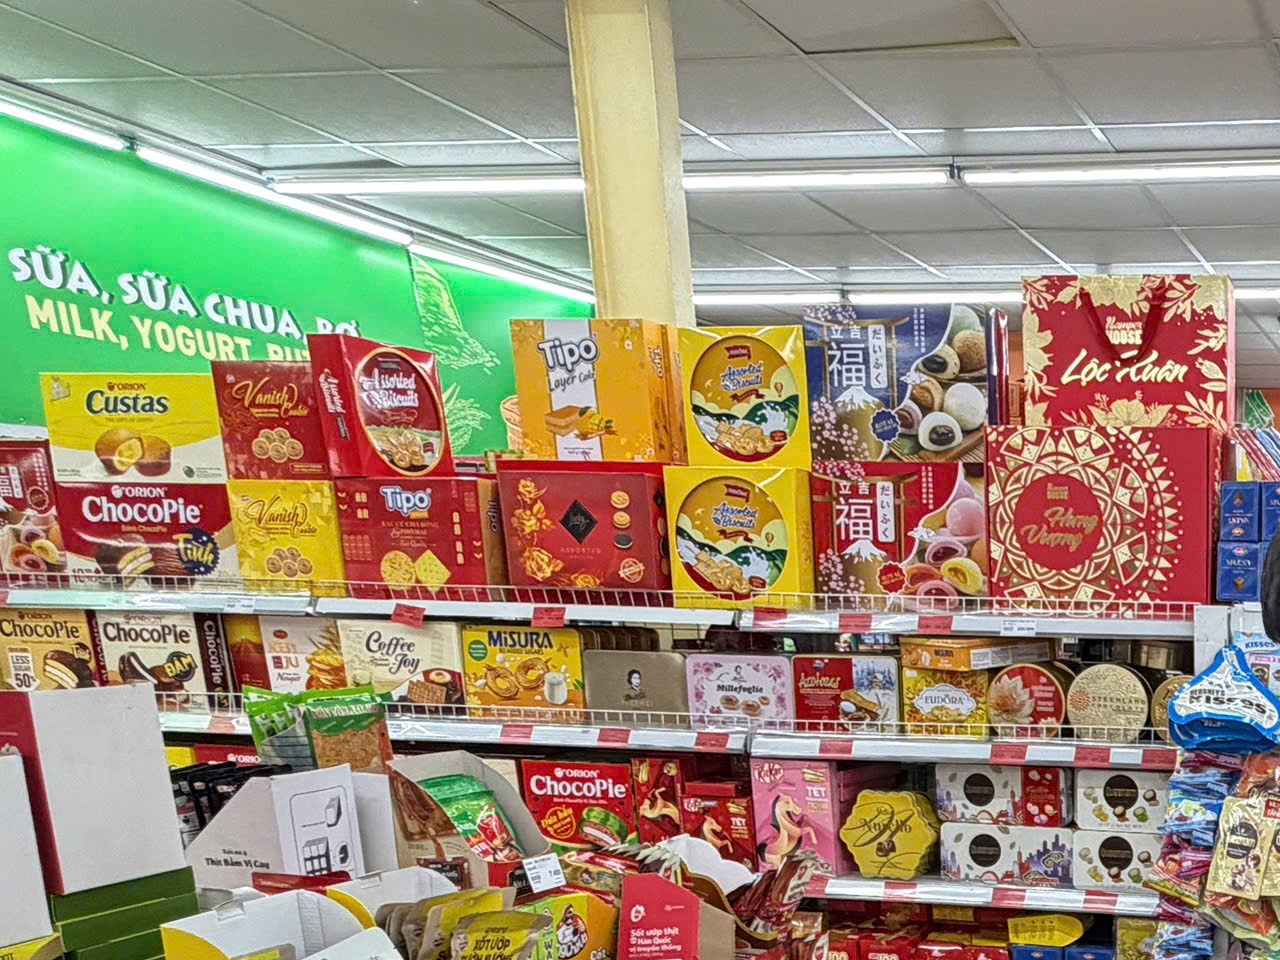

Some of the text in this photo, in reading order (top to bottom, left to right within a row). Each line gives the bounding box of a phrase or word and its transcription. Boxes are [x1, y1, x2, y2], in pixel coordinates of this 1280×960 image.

[9, 245, 114, 305] SỮA,
[118, 270, 200, 319] SỮA
[26, 295, 129, 351] MILK,
[538, 337, 599, 373] Tipo
[828, 341, 866, 388] 福
[86, 389, 169, 416] Custas
[121, 486, 167, 499] ORION
[380, 486, 432, 510] Tipo
[82, 497, 201, 524] ChocoPie
[836, 498, 874, 540] 福
[0, 619, 80, 640] ChocoPie
[103, 622, 191, 646] ChocoPie
[366, 631, 415, 654] Coffee
[530, 776, 627, 799] ChocoPie
